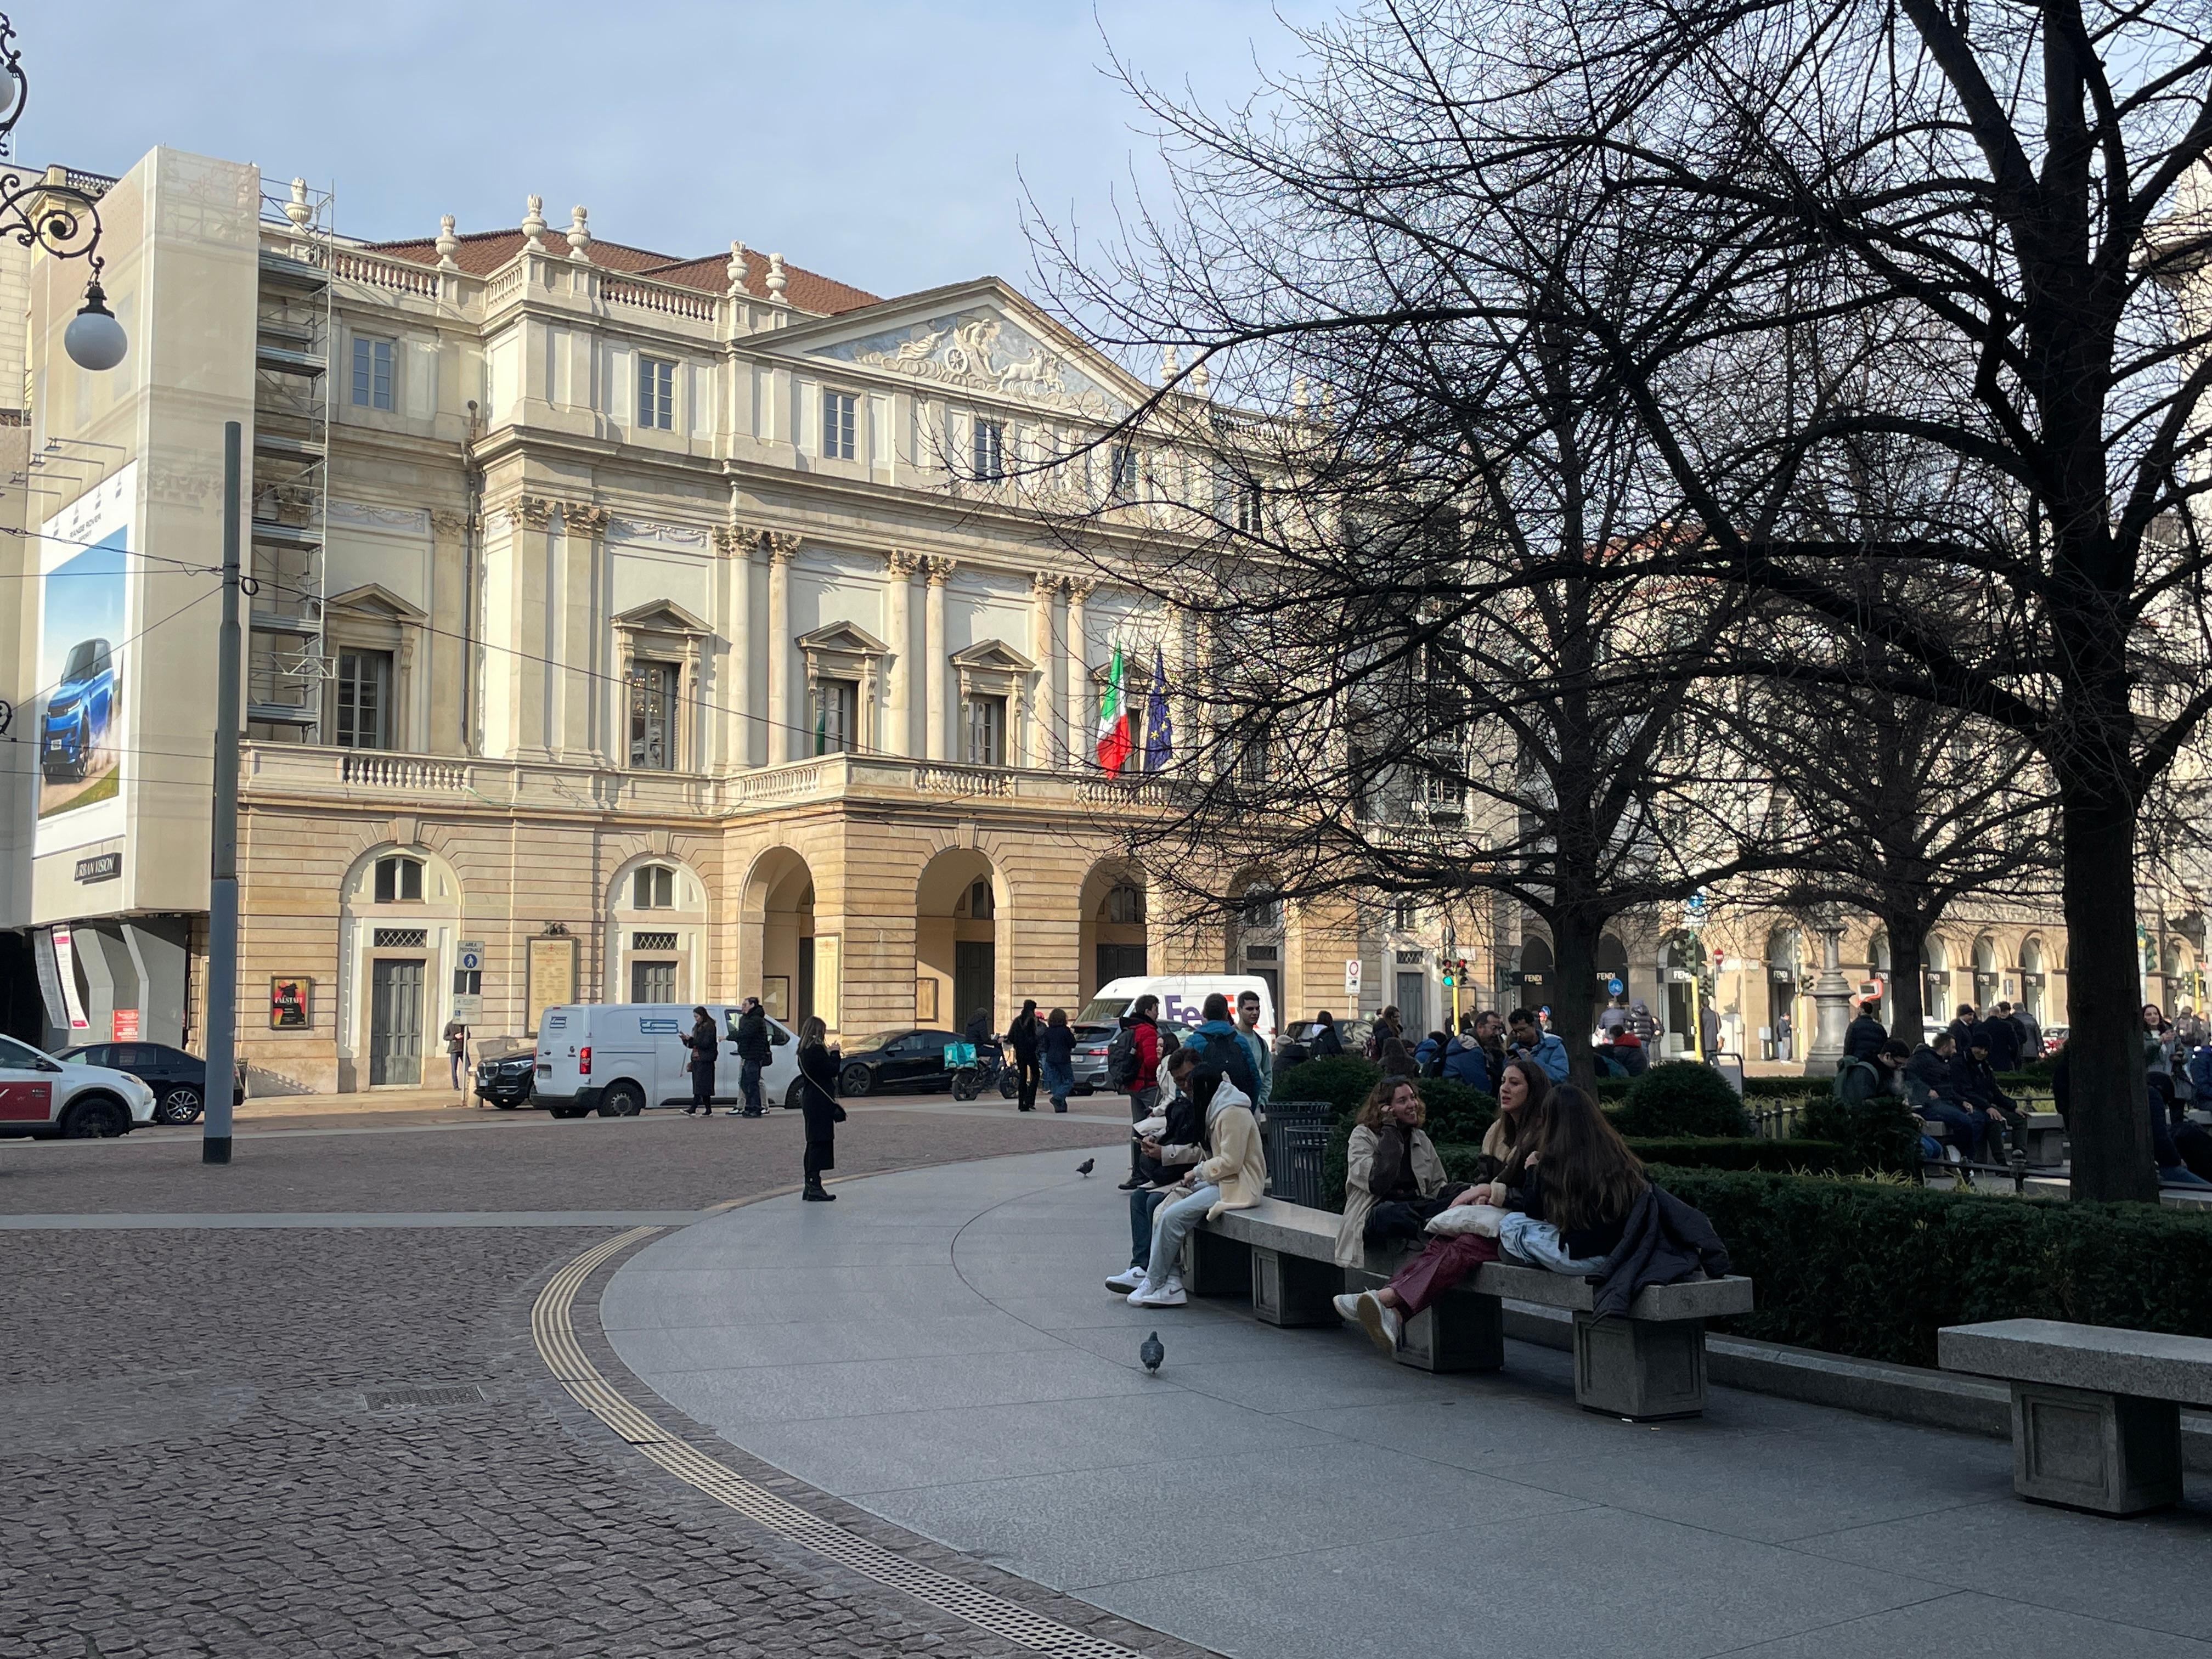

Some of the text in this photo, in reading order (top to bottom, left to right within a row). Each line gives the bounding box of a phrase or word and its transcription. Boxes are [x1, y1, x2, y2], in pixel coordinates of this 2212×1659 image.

[75, 857, 115, 878] URBAN VISION
[1774, 970, 1788, 979] FENDI
